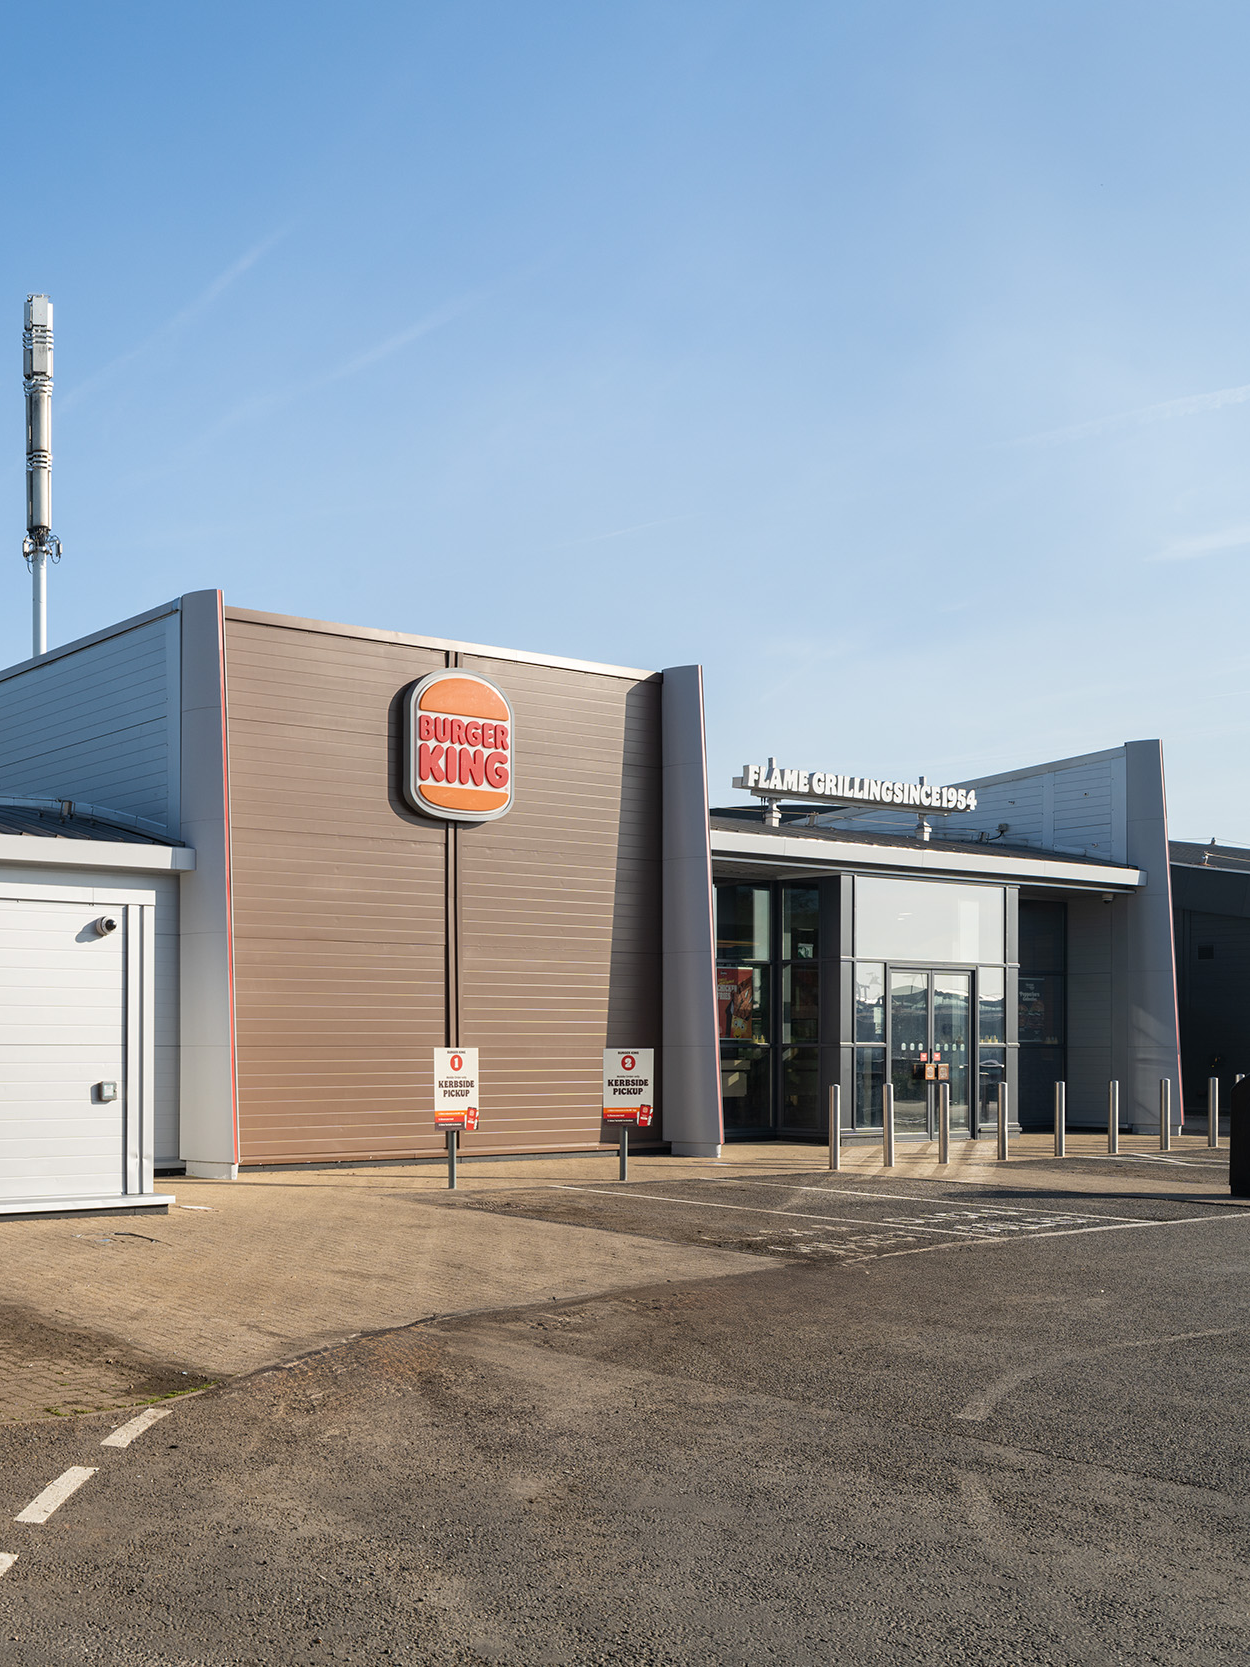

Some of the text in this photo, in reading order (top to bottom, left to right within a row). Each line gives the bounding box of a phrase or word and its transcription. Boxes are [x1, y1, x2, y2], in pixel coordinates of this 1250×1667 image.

[418, 714, 510, 751] BURGER
[418, 742, 510, 789] KING
[747, 765, 809, 792] FLAME
[453, 1057, 459, 1069] 1
[624, 1058, 632, 1068] 2
[438, 1080, 475, 1088] KERBSIDE
[607, 1079, 649, 1087] KERBSIDE
[443, 1089, 470, 1097] PICKUP
